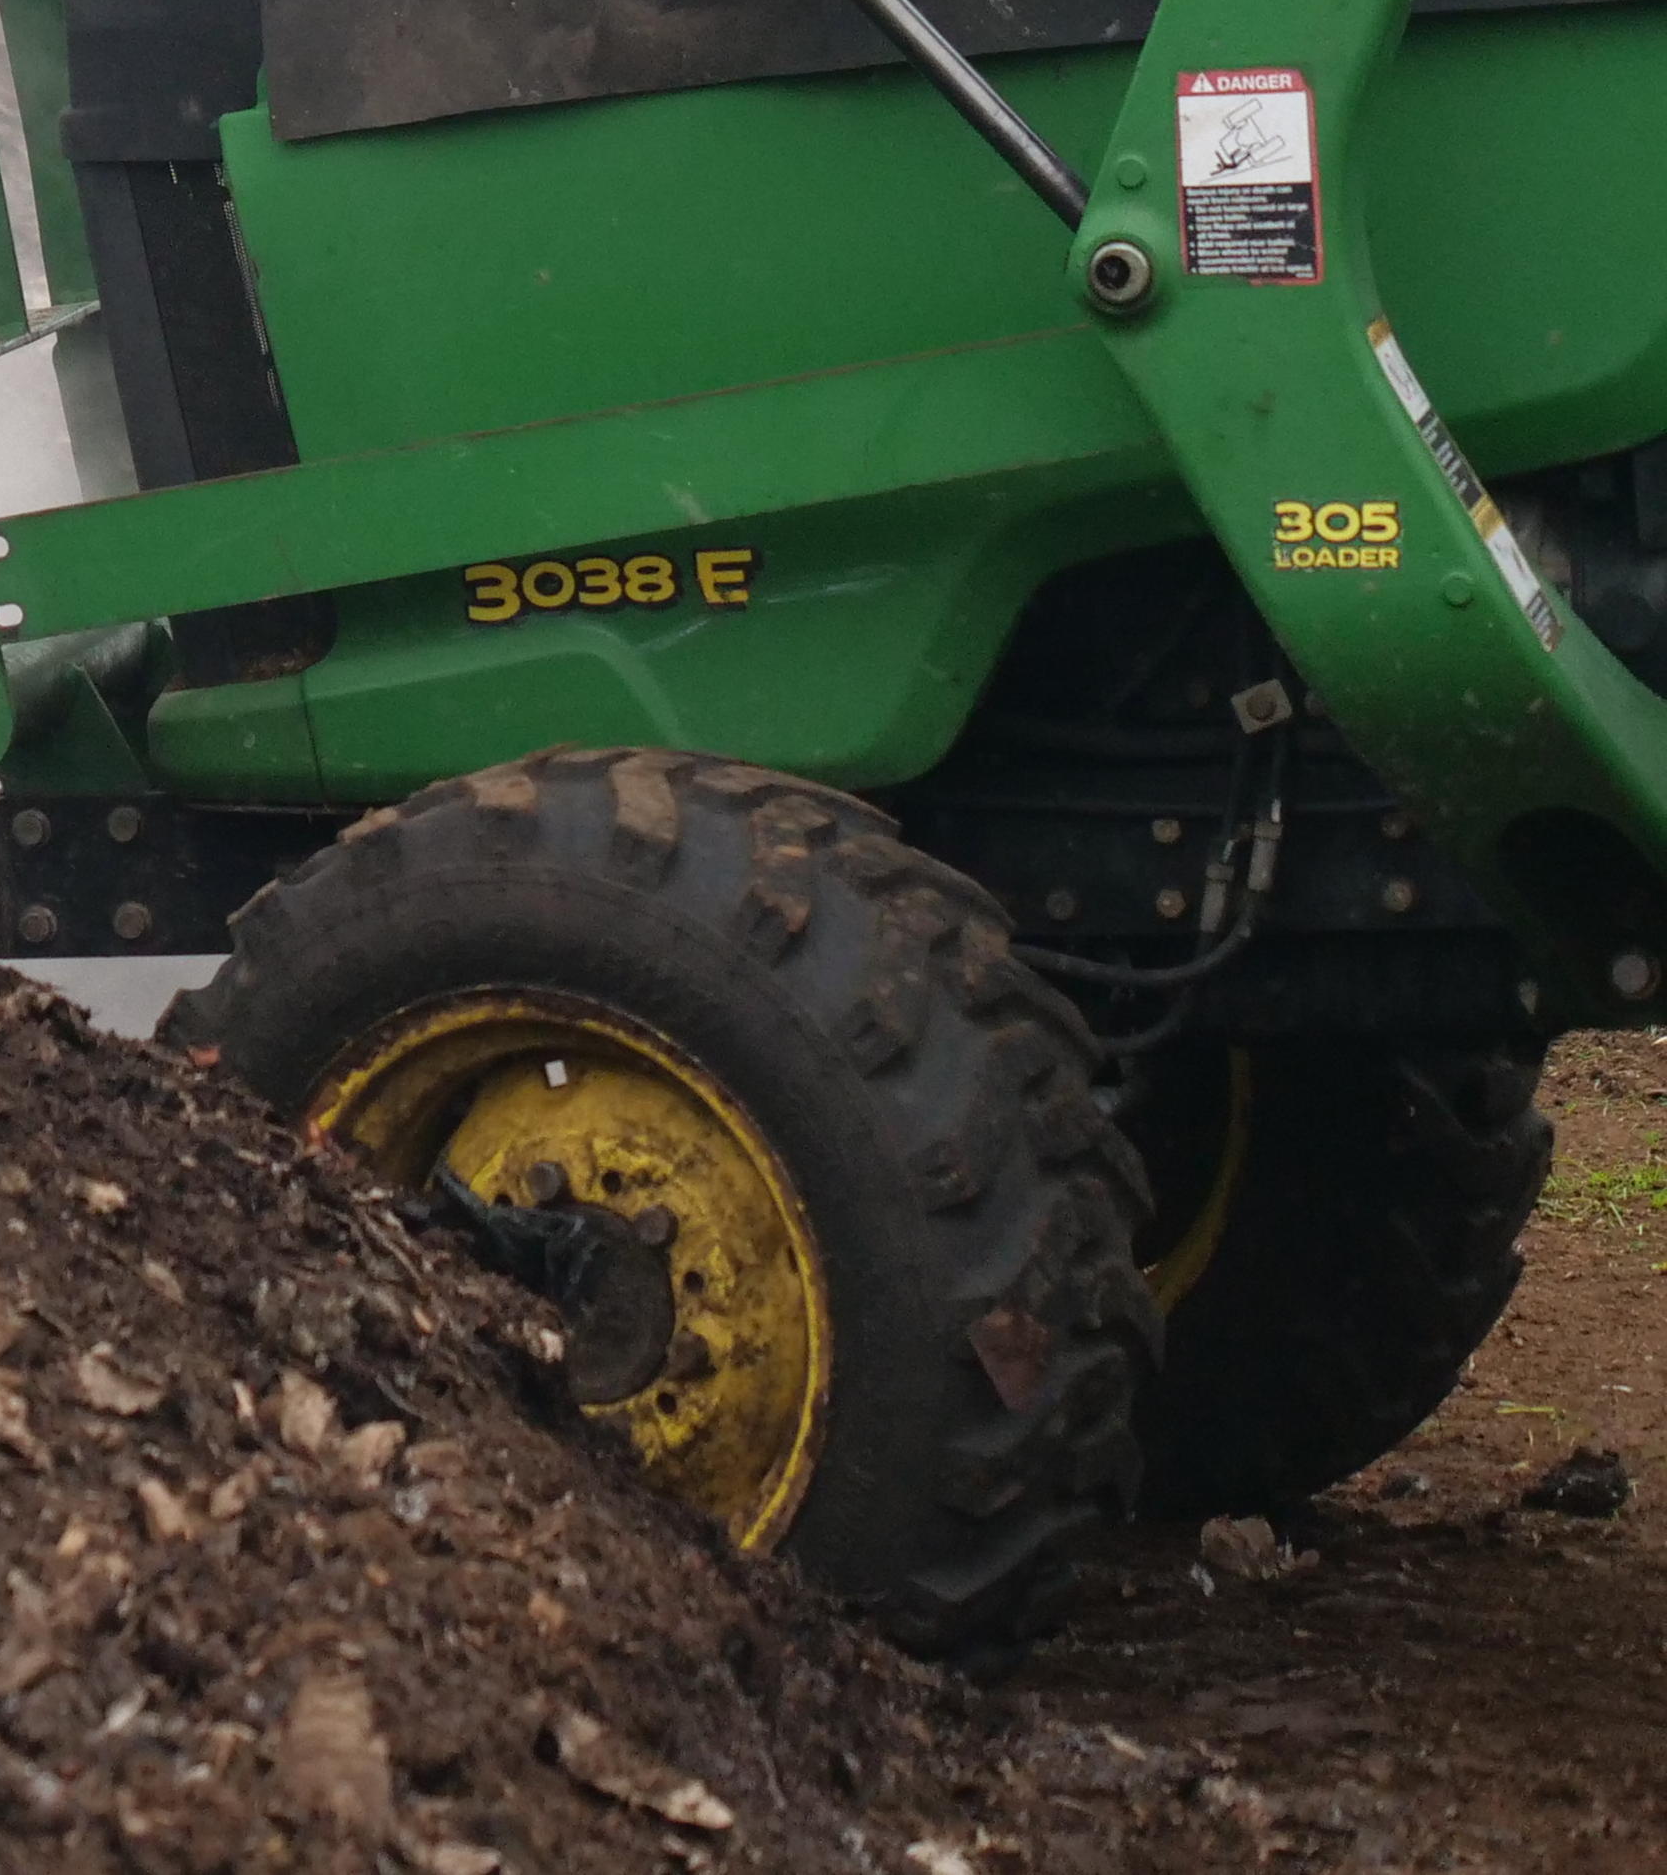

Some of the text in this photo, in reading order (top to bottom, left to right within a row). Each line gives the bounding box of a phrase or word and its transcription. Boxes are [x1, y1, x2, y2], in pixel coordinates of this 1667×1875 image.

[1218, 73, 1293, 91] DANGER
[1274, 501, 1400, 543] 305
[1275, 546, 1400, 569] LOADER
[465, 549, 753, 622] 3038 E
